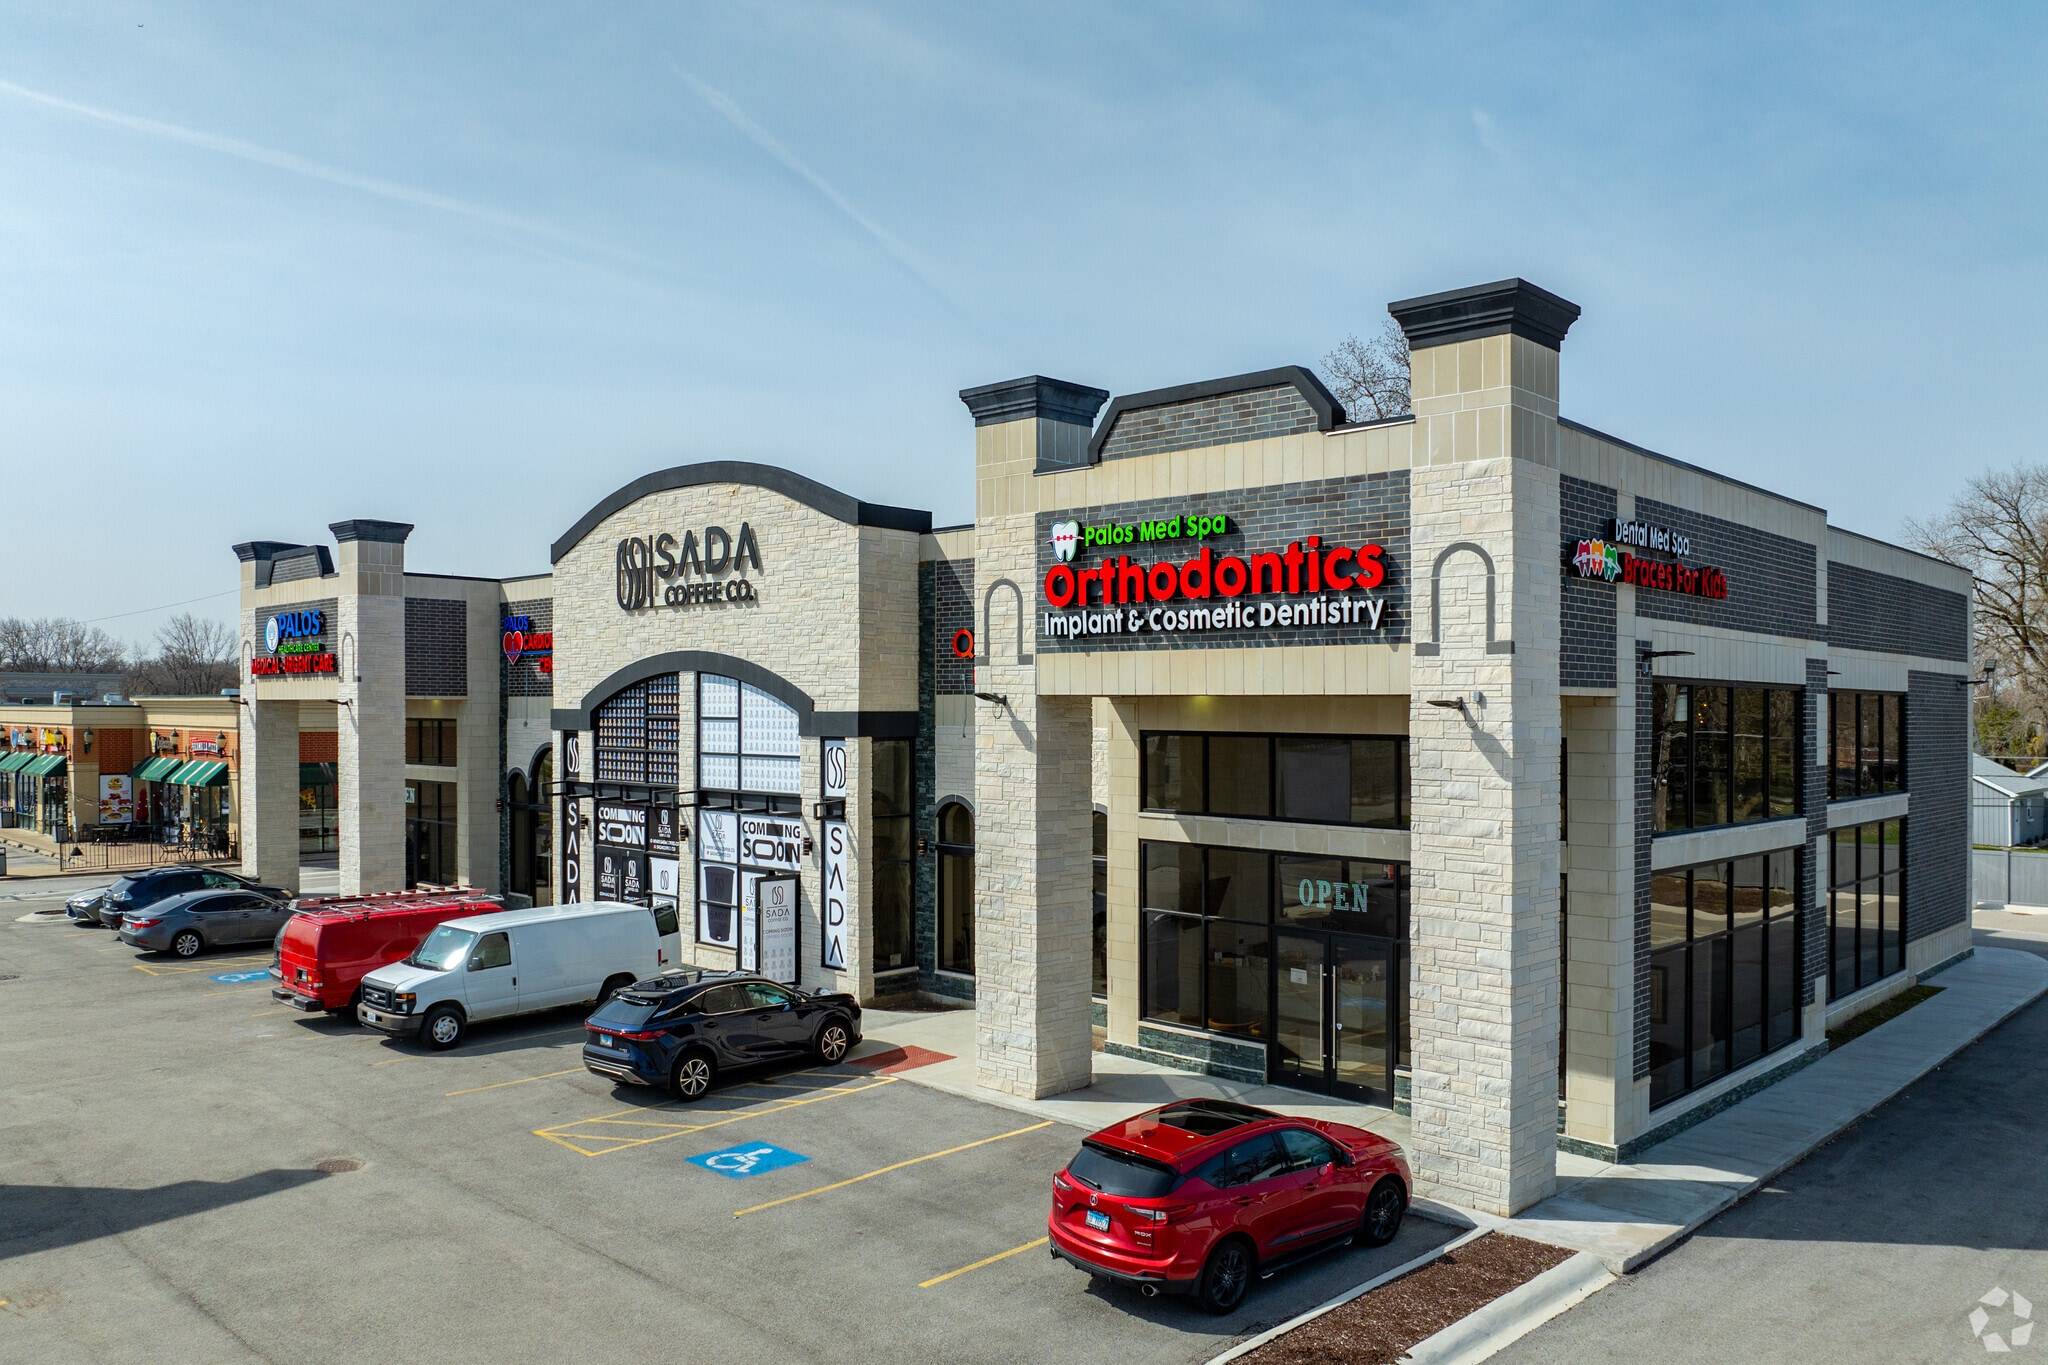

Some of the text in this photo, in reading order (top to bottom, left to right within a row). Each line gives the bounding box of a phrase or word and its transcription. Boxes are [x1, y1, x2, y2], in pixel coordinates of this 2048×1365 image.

[1085, 514, 1226, 546] Palos Med Spa
[1615, 518, 1689, 558] Dental Med Spa
[656, 522, 758, 579] SADA
[1044, 536, 1384, 607] Orthodontics
[1624, 552, 1727, 599] Braces For Kids
[665, 579, 754, 607] COFFEE CO.
[278, 609, 320, 638] PALOS
[504, 615, 529, 631] PALOS
[1044, 595, 1384, 640] Implant & Cosmetic Dentistry
[523, 633, 553, 650] CARDIO
[252, 656, 280, 674] MEDICAL
[284, 654, 312, 673] URGENT
[313, 653, 334, 673] CARE
[598, 822, 645, 845] SOON
[743, 838, 800, 863] SOON
[829, 826, 844, 964] SADA
[1299, 878, 1369, 913] OPEN
[765, 908, 790, 918] SADA
